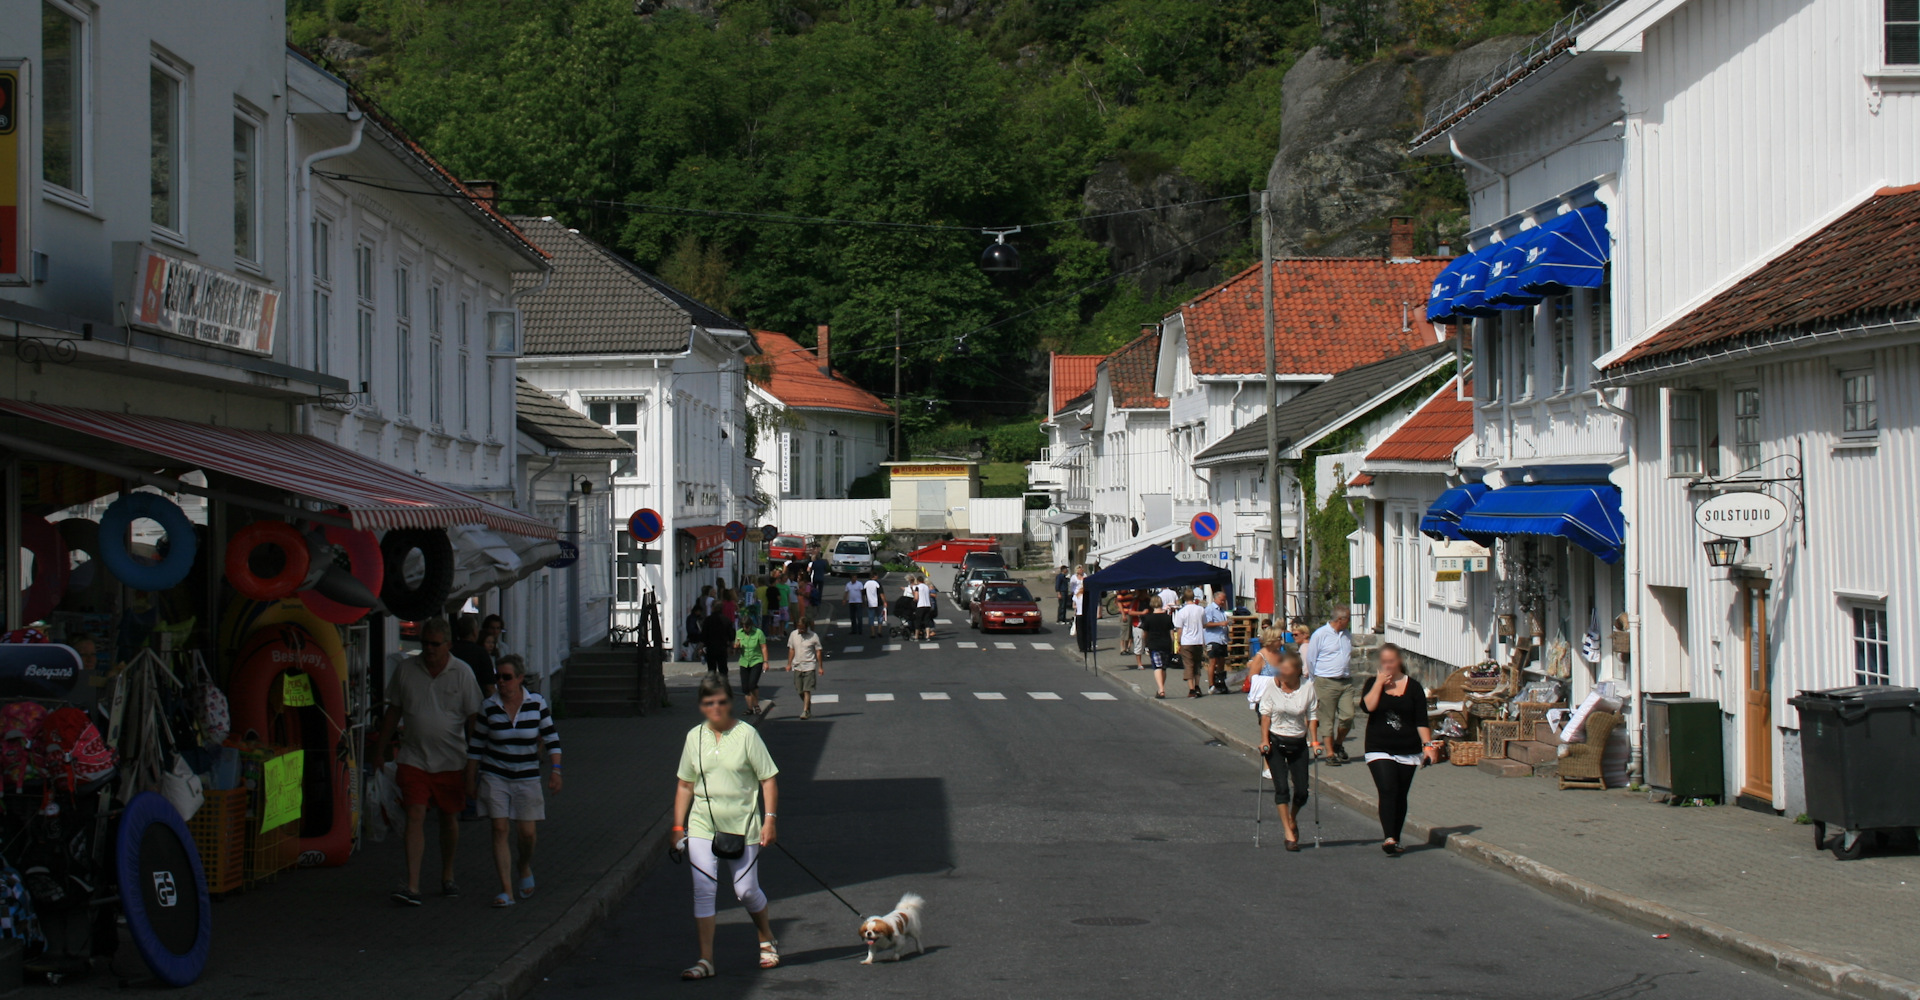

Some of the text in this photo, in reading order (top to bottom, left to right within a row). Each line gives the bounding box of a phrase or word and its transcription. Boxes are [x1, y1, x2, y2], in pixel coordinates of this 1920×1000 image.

[1705, 509, 1771, 522] SOLSTUDIO
[1196, 552, 1217, 561] Tjenna
[271, 649, 322, 668] Bestway
[24, 664, 73, 680] Bergans
[300, 852, 323, 865] 200
